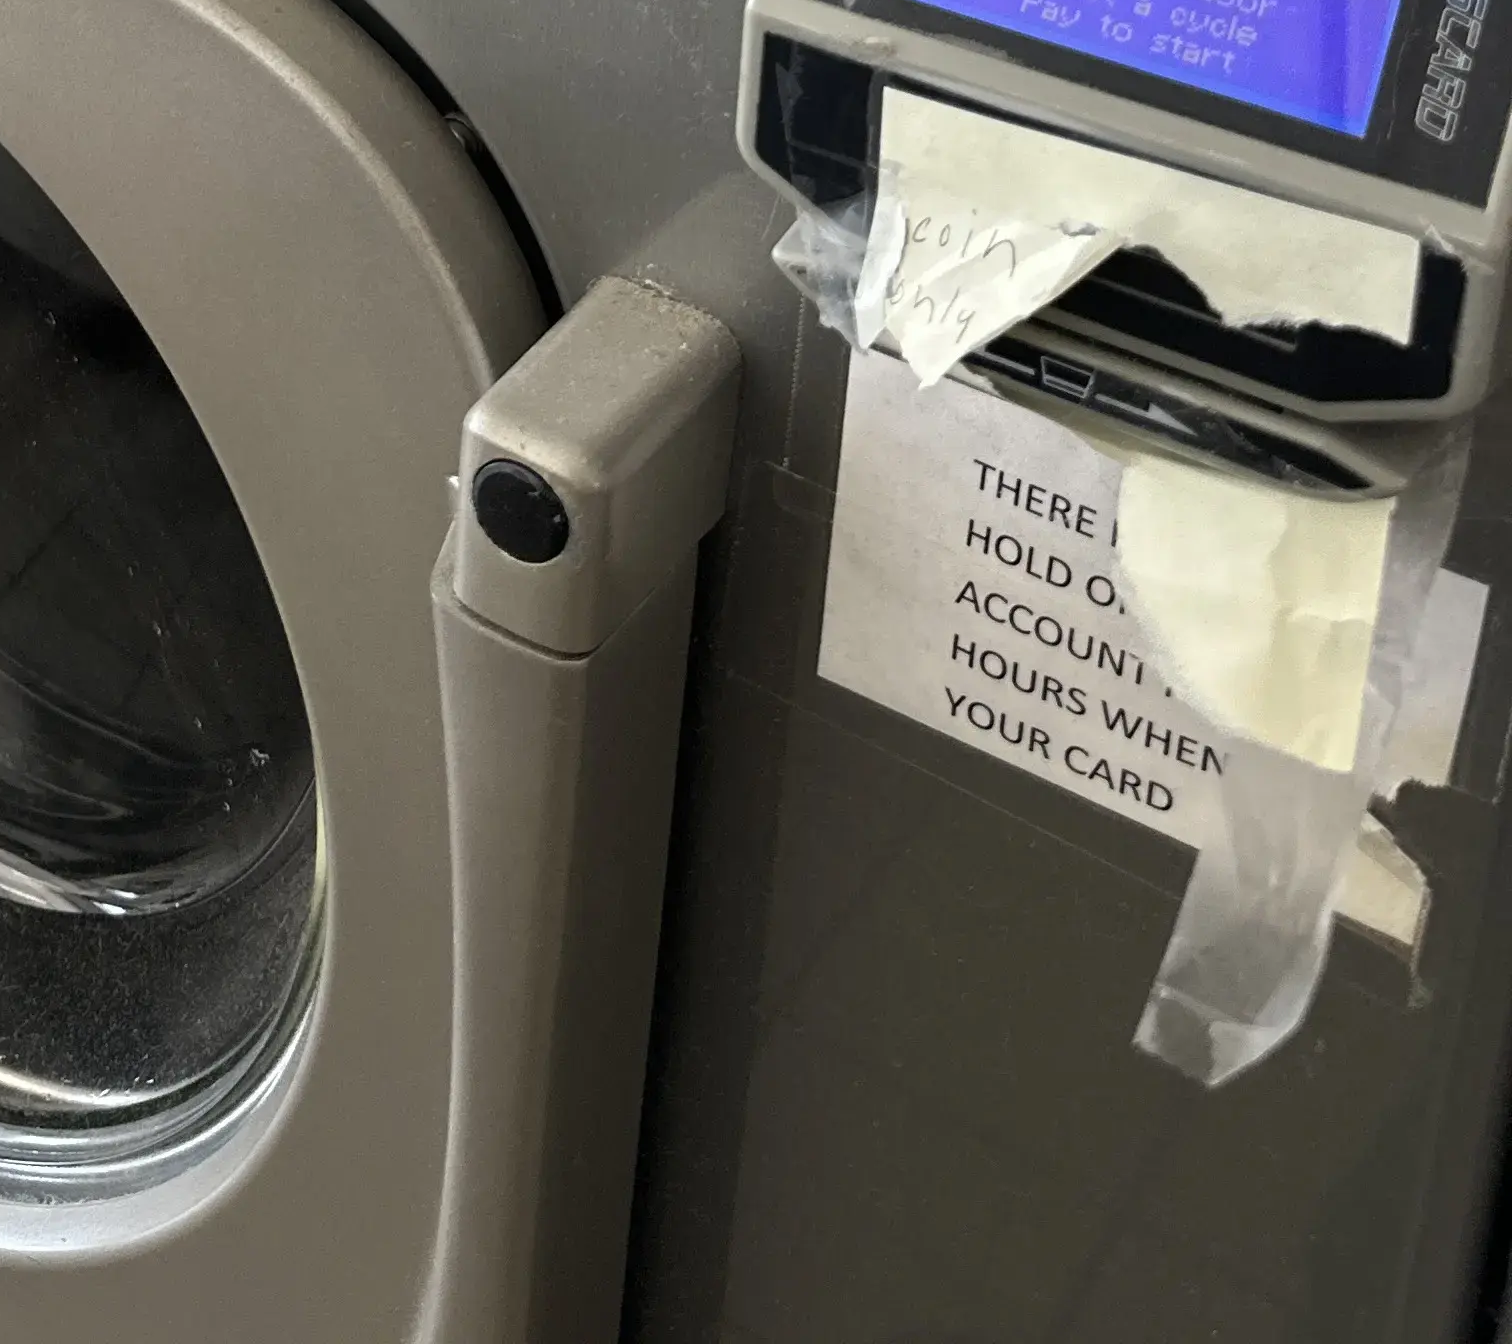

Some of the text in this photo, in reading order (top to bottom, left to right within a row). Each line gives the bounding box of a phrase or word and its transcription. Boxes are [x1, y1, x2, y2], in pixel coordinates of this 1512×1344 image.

[1099, 11, 1134, 42] to
[1150, 31, 1238, 75] start
[1169, 2, 1259, 48] cycle
[972, 458, 1097, 537] THERE
[964, 517, 1073, 590] HOLD
[953, 580, 1147, 687] ACCOUNT
[950, 633, 1228, 776] HOURS WHEN
[943, 687, 1176, 814] YOUR CARD
